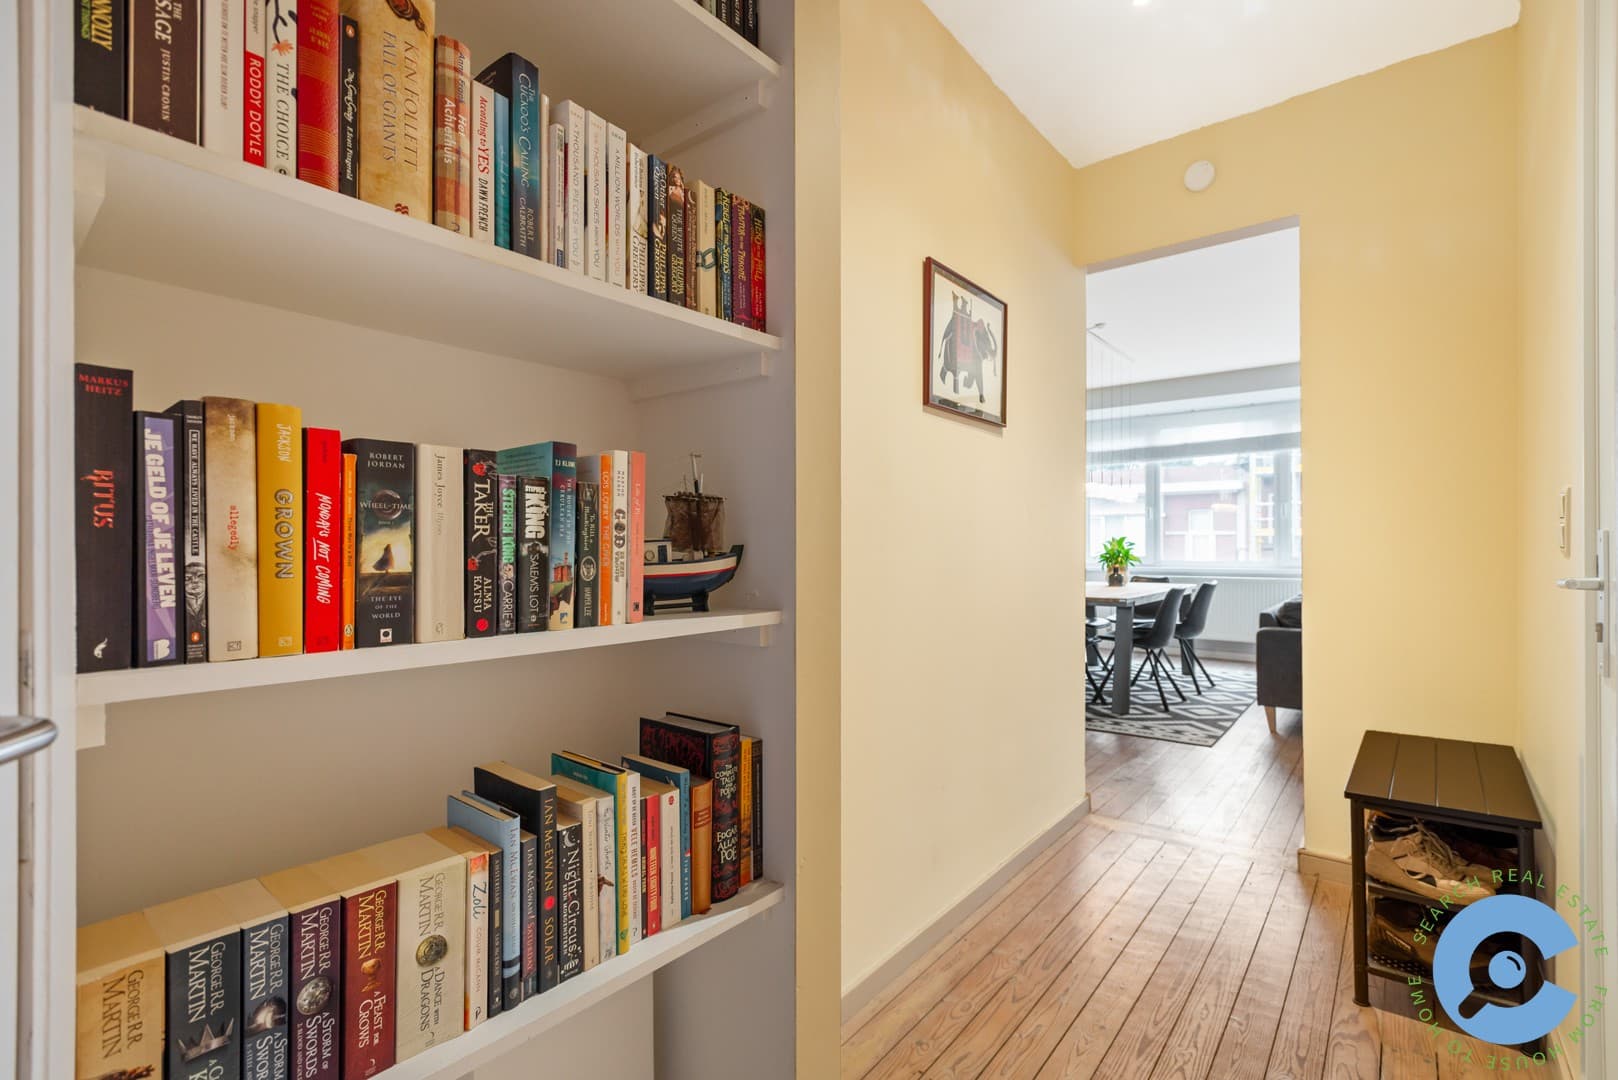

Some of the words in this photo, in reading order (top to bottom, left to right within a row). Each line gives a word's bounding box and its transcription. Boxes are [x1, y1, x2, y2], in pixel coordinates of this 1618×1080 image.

[173, 2, 183, 21] THE
[161, 48, 171, 81] JUSTIN
[383, 30, 396, 66] FALL
[403, 40, 419, 82] KEN
[249, 58, 263, 107] RODDY
[276, 64, 290, 96] THE
[383, 72, 396, 97] OF
[161, 84, 171, 122] CRONIN
[249, 109, 263, 157] DOYLE
[275, 99, 290, 161] CHOICE
[383, 99, 396, 162] GIANTS
[403, 87, 419, 171] FOLLETT
[477, 147, 490, 175] YES
[518, 135, 532, 188] CALLING
[478, 177, 489, 203] DAWN
[478, 203, 490, 232] FRENCH
[632, 235, 641, 293] GREGORY
[639, 242, 647, 292] PHILIPPA
[654, 238, 662, 290] GREGORY
[659, 241, 667, 293] PHILIPPA
[79, 374, 128, 388] MARKUS
[85, 383, 123, 397] HEITZ
[144, 428, 163, 452] JE
[275, 423, 294, 464] JACKSON
[369, 452, 404, 461] ROBERT
[145, 453, 167, 499] GELD
[367, 460, 405, 470] JORDAN
[435, 454, 446, 481] James
[81, 468, 116, 529] RITUS
[150, 501, 170, 525] OF
[314, 493, 333, 538] MONDAY'S
[359, 501, 387, 510] WHEEL
[392, 503, 412, 511] TIME
[434, 482, 446, 509] Joyce
[472, 479, 491, 542] TAKER
[502, 488, 516, 534] STEPHEN
[525, 493, 549, 539] KING
[153, 527, 172, 550] JE
[226, 504, 240, 552] allegedly
[274, 489, 295, 580] GROWN
[614, 508, 627, 550] GOD
[316, 540, 331, 563] NOT
[502, 536, 516, 564] KING
[155, 552, 177, 609] LEVEN
[314, 565, 334, 605] COMING
[389, 595, 402, 603] EYE
[473, 576, 483, 613] KATSU
[483, 576, 493, 611] ALMA
[503, 580, 515, 619] CARRIE
[371, 612, 401, 620] WORLD
[529, 594, 540, 613] LOT
[544, 798, 554, 826] IAN
[527, 847, 535, 868] IAN
[544, 829, 554, 892] McEWAN
[564, 848, 580, 898] Night
[720, 846, 738, 864] POE
[374, 889, 387, 932] GEORGE
[419, 874, 435, 937] MARTIN
[434, 871, 446, 913] GEORGE
[472, 881, 488, 920] Zoli
[269, 923, 284, 970] GEORGE
[300, 909, 319, 981] MARTIN
[318, 907, 333, 953] GEORGE
[358, 892, 375, 960] MARTIN
[544, 916, 555, 966] SOLAR
[567, 900, 581, 955] Circus
[187, 944, 210, 1025] MARTIN
[209, 941, 226, 991] GEORGE
[249, 926, 270, 1001] MARTIN
[127, 969, 145, 1022] GEORGE
[420, 968, 434, 1033] DRAGONS
[433, 971, 446, 1007] DANCE
[102, 974, 126, 1060] MARTIN
[358, 999, 374, 1049] CROWS
[373, 995, 387, 1030] FEAST
[304, 1014, 322, 1079] SWORDS
[322, 1018, 336, 1059] STORM
